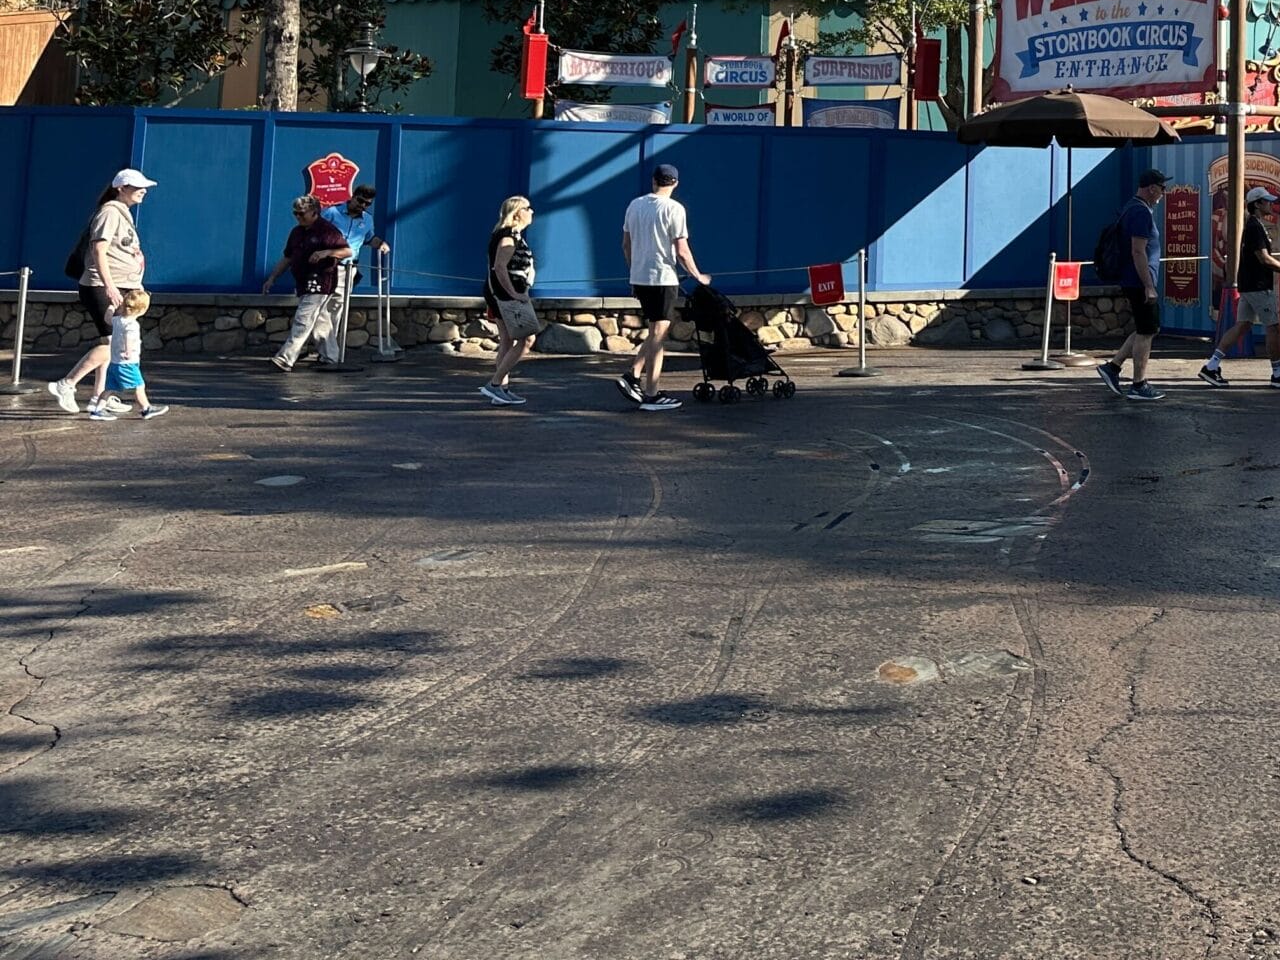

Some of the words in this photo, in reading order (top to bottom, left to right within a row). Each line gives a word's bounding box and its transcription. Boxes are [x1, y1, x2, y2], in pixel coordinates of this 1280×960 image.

[1095, 4, 1109, 20] to
[1111, 0, 1131, 18] the
[1034, 26, 1132, 58] STORYBOOK
[1136, 24, 1188, 47] CIRCUS
[568, 57, 665, 80] MYSTERIOUS
[812, 60, 893, 80] SURPRISING
[715, 70, 768, 83] CIRCUS
[713, 112, 720, 122] A
[722, 112, 757, 122] WORLD
[758, 111, 770, 122] OF
[1177, 200, 1187, 208] AN
[1167, 211, 1196, 220] AMAZING
[1171, 224, 1194, 232] WORLD
[1167, 244, 1197, 254] CIRCUS
[817, 280, 836, 292] EXIT
[1059, 277, 1073, 287] EXIT
